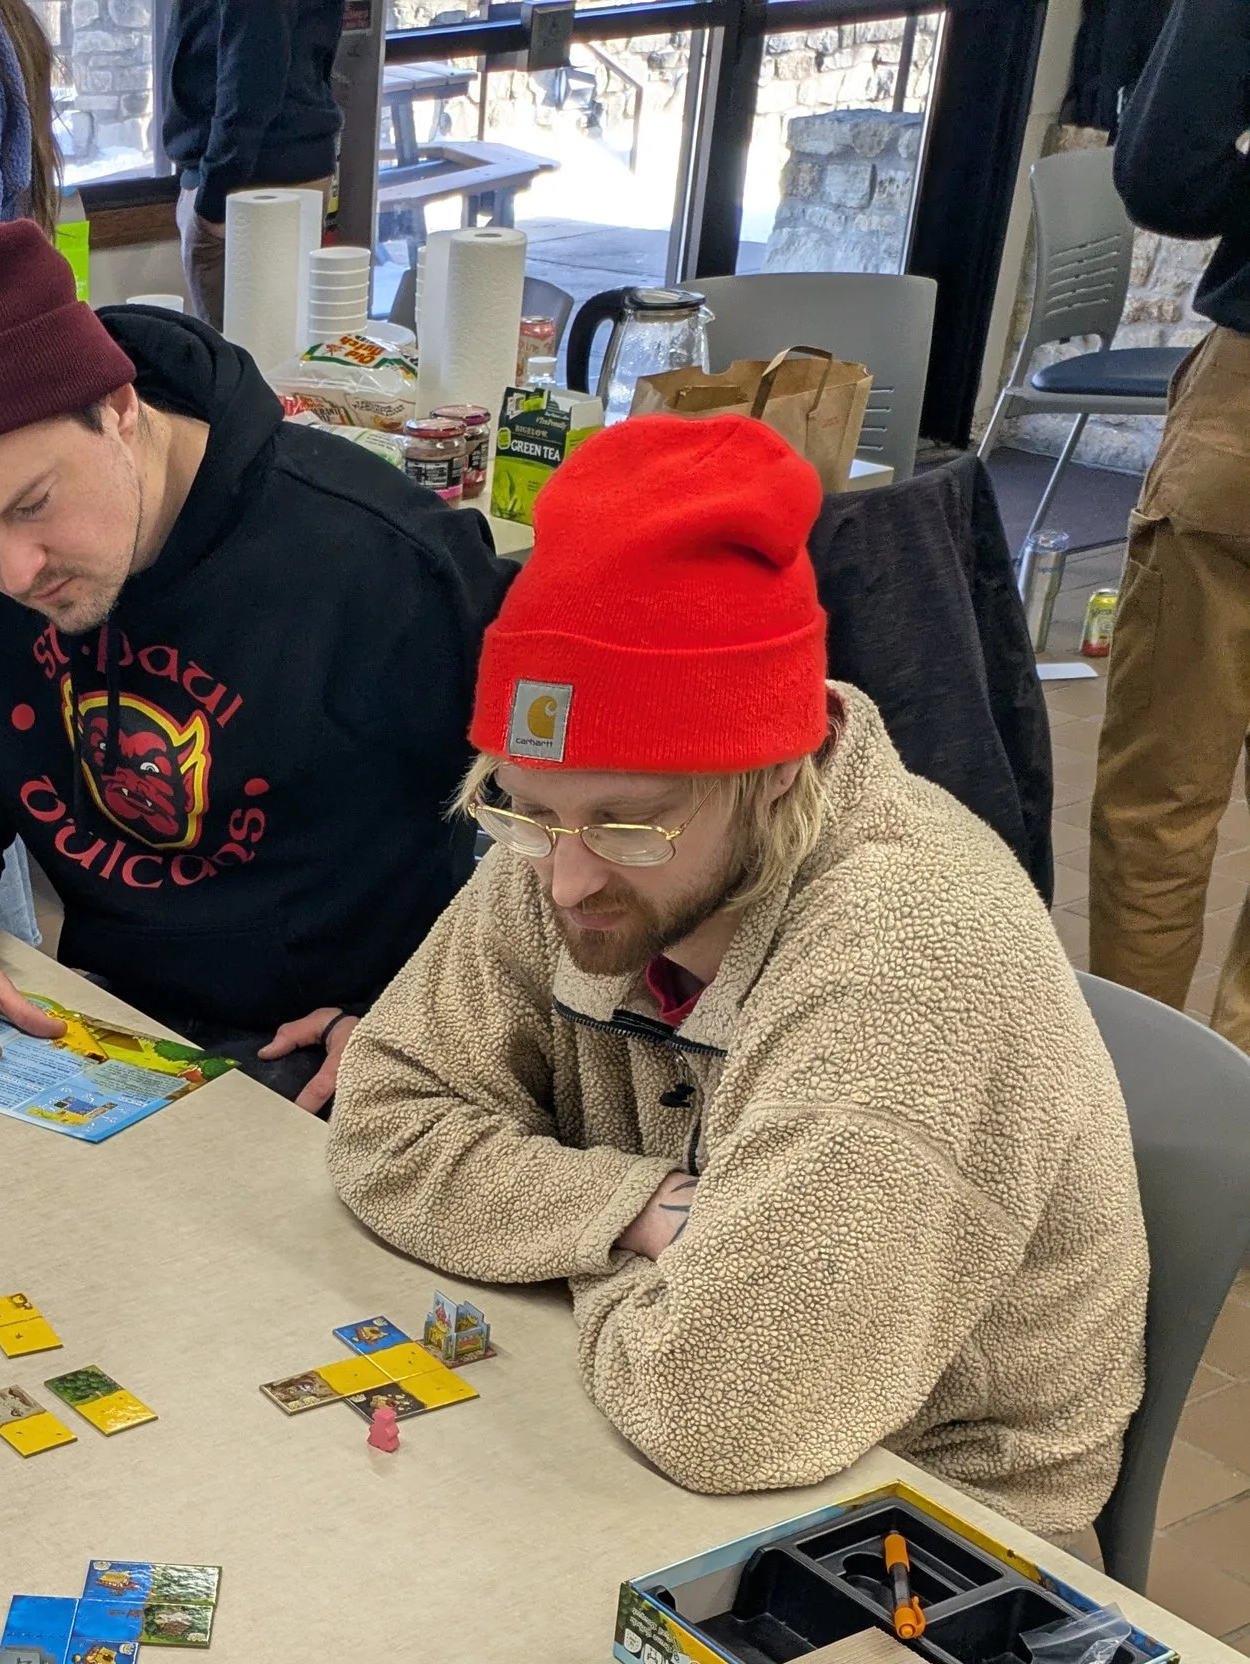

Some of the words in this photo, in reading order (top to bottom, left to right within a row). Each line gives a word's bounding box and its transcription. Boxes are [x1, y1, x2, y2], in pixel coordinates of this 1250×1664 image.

[343, 350, 376, 365] Old
[514, 424, 550, 437] BIGELOW
[510, 439, 542, 457] GREEN
[543, 446, 562, 462] TEA
[515, 737, 554, 748] carhartt
